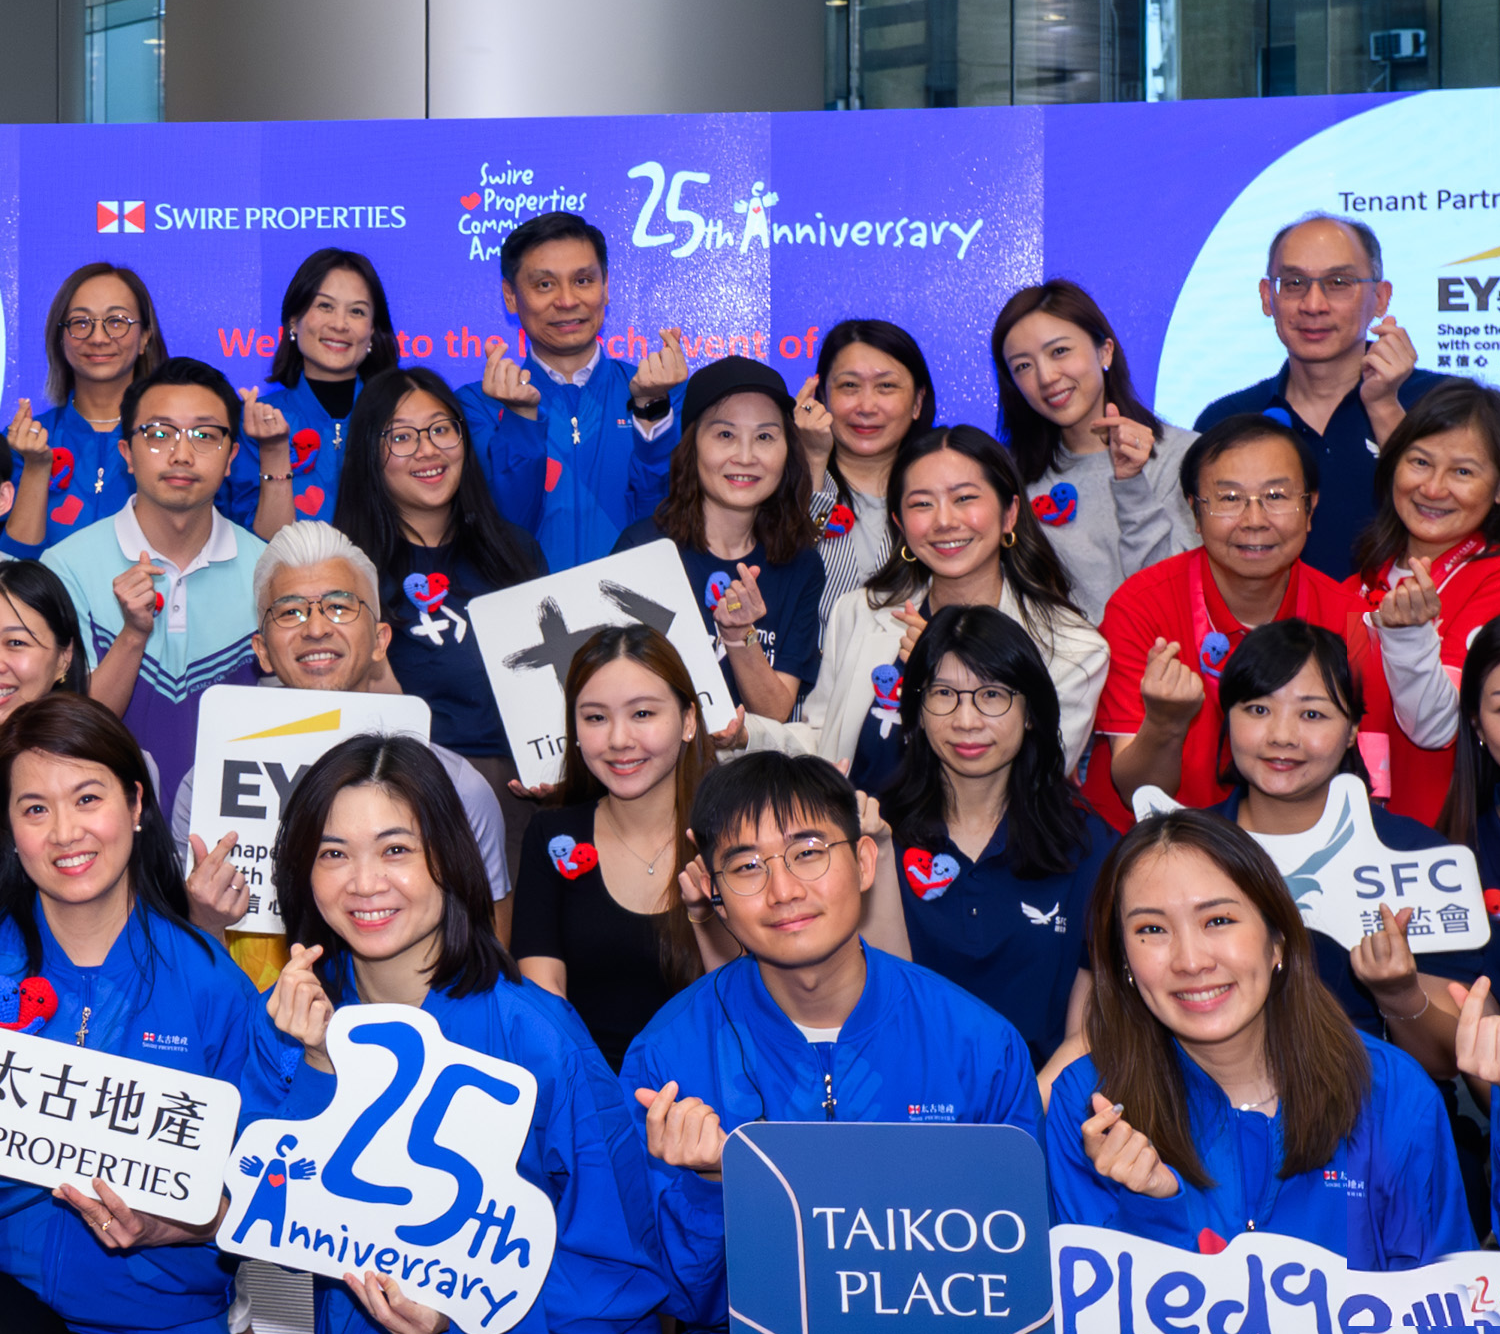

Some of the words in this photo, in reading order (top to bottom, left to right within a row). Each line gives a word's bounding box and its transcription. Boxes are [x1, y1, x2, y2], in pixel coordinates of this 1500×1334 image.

[479, 160, 534, 187] Swire
[154, 203, 240, 230] SWIRE
[245, 205, 407, 230] PROPERTIES
[483, 185, 588, 219] Properties
[627, 160, 734, 259] 25th
[738, 187, 984, 260] Anniversary
[1338, 190, 1427, 212] Tenant
[398, 329, 434, 358] to
[678, 329, 767, 359] vent
[778, 325, 820, 359] of
[1437, 323, 1480, 338] Shape
[1437, 339, 1470, 351] with
[220, 759, 314, 821] EY
[1352, 858, 1463, 900] SFC
[320, 1021, 531, 1269] 25th
[231, 1157, 519, 1328] Anniversary
[812, 1206, 1027, 1254] TAIKOO
[835, 1270, 1011, 1317] PLACE
